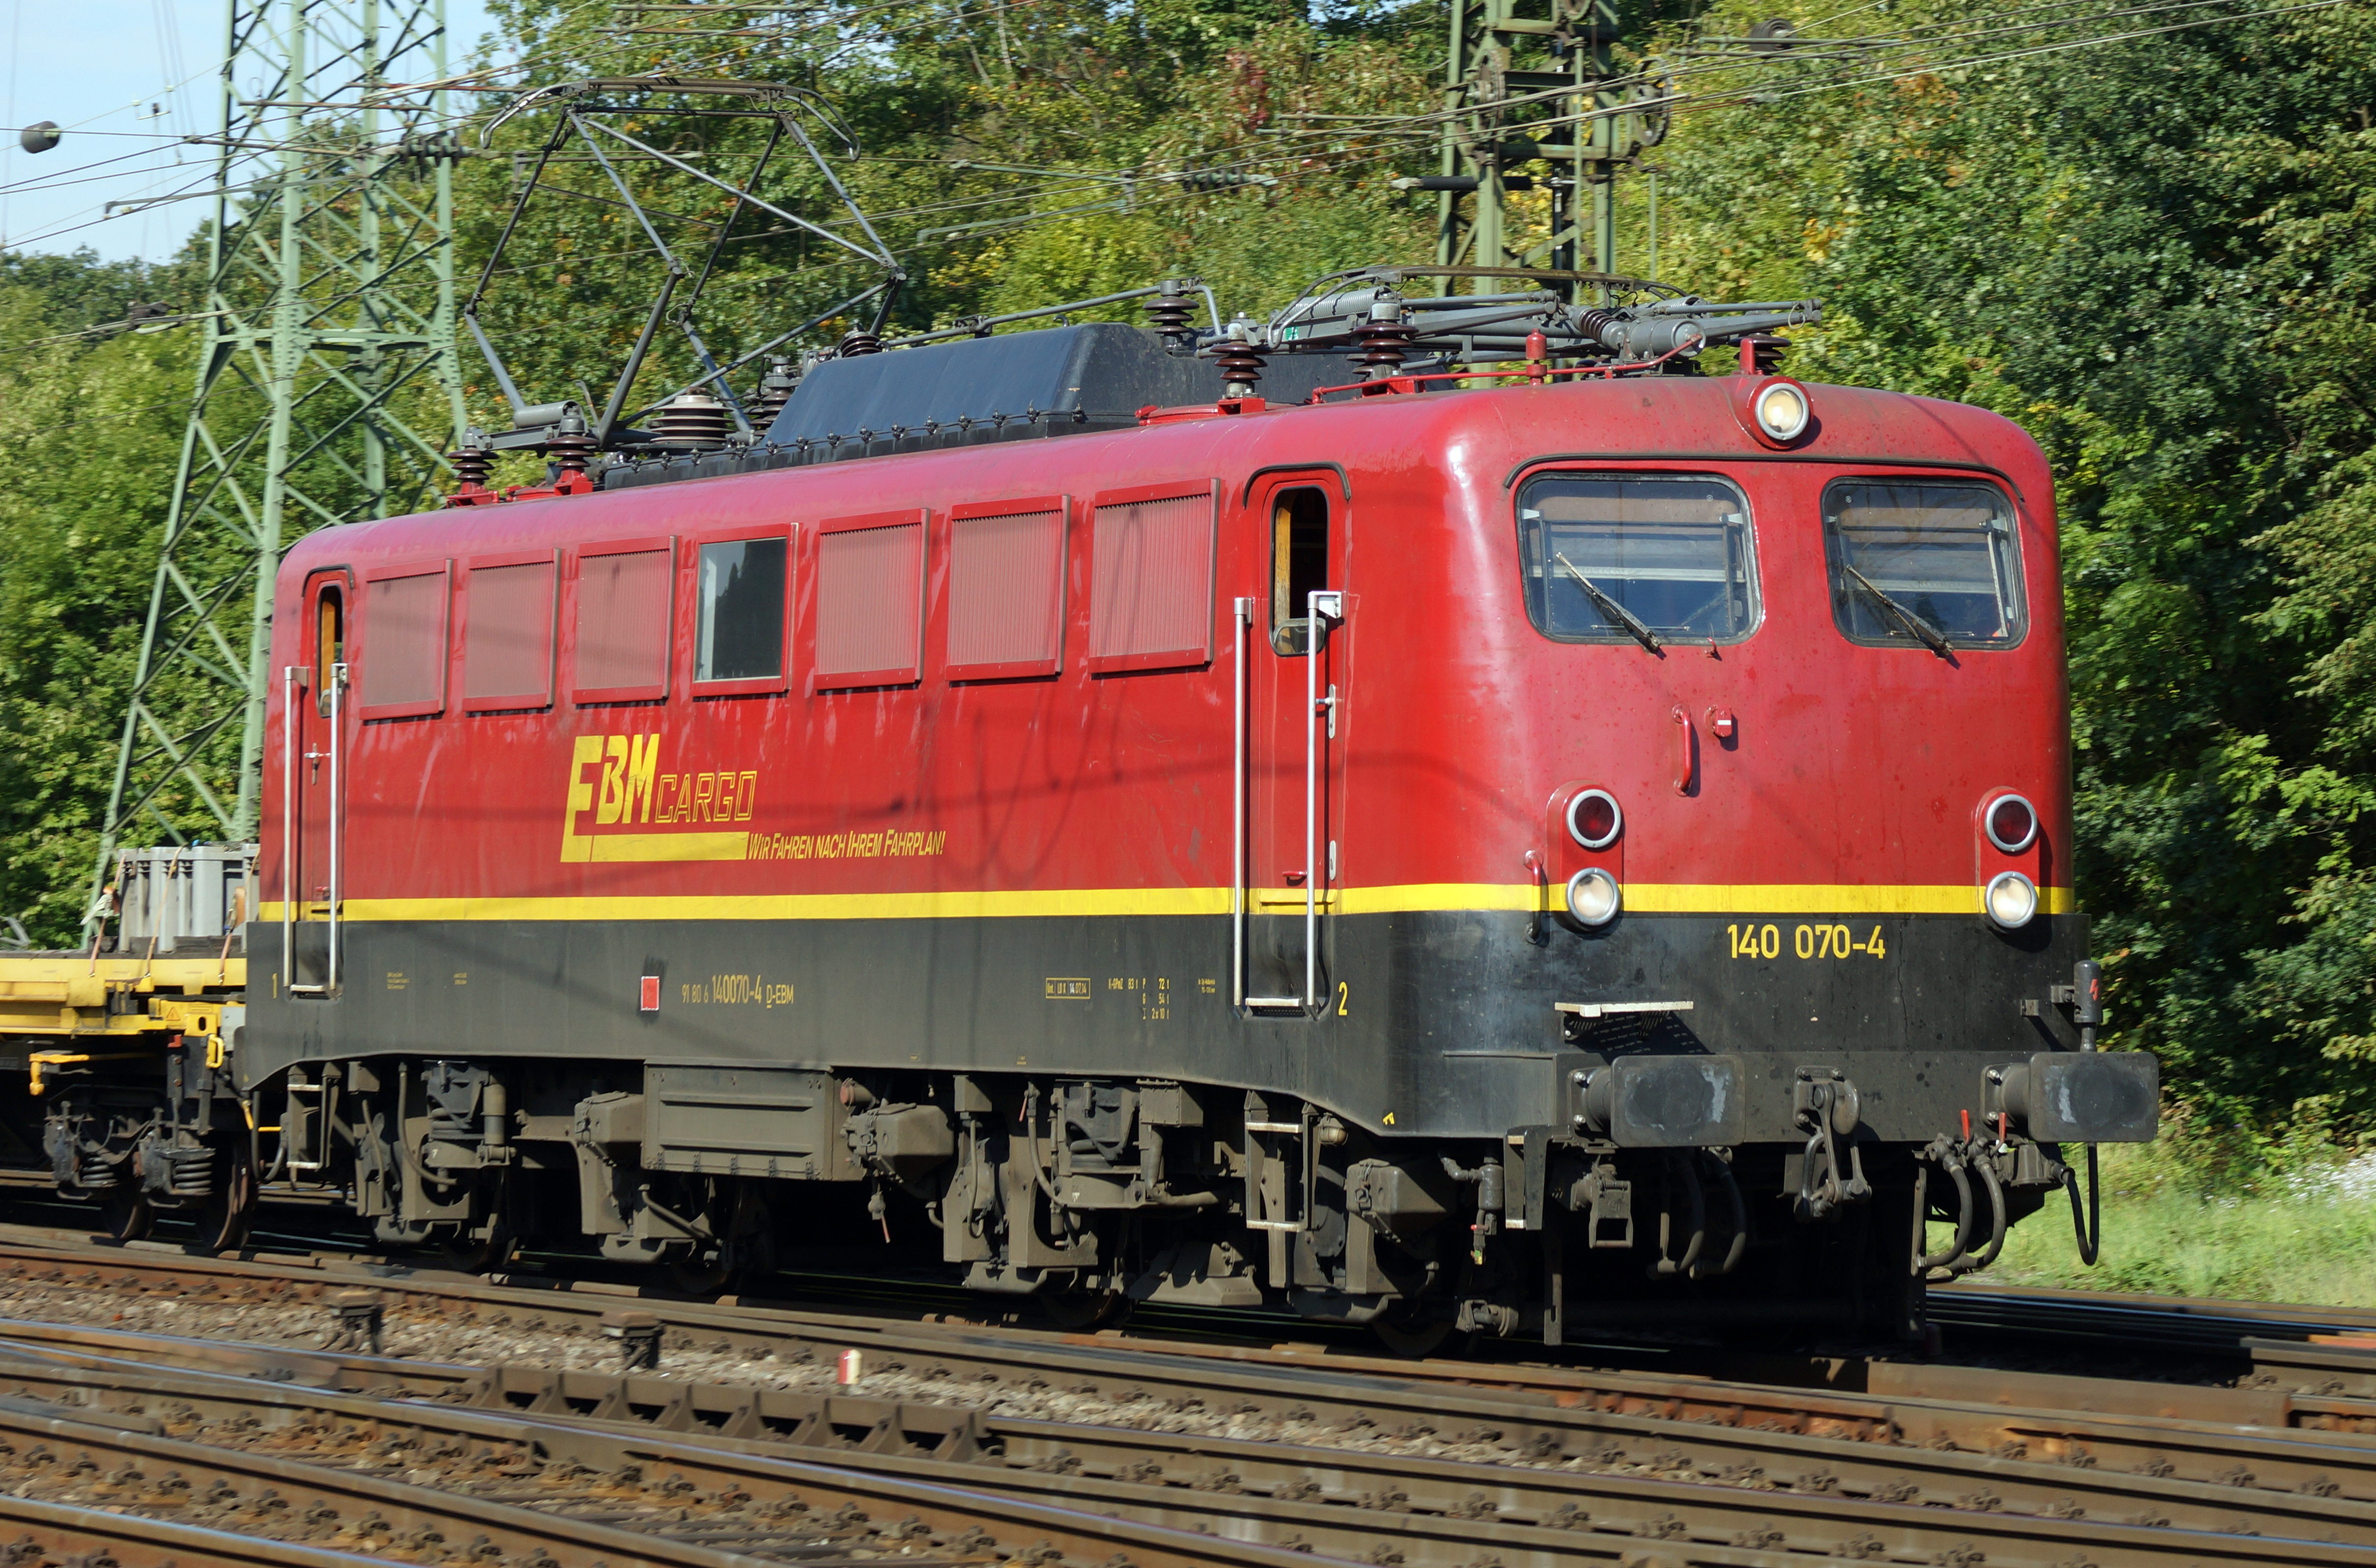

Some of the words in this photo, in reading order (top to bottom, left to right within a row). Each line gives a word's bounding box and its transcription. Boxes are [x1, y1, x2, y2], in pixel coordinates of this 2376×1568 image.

[560, 733, 661, 863] EBM
[654, 770, 757, 824] CARGO
[1728, 924, 1779, 959] 140
[1795, 924, 1885, 959] 070-4
[272, 973, 277, 999] 1
[682, 984, 689, 1003] 91
[692, 984, 701, 1003] 80
[704, 985, 709, 1003] 6
[712, 974, 762, 1004] 140070-4
[766, 984, 794, 1009] D-EBM
[1158, 978, 1165, 990] 72
[1338, 982, 1347, 1016] 2
